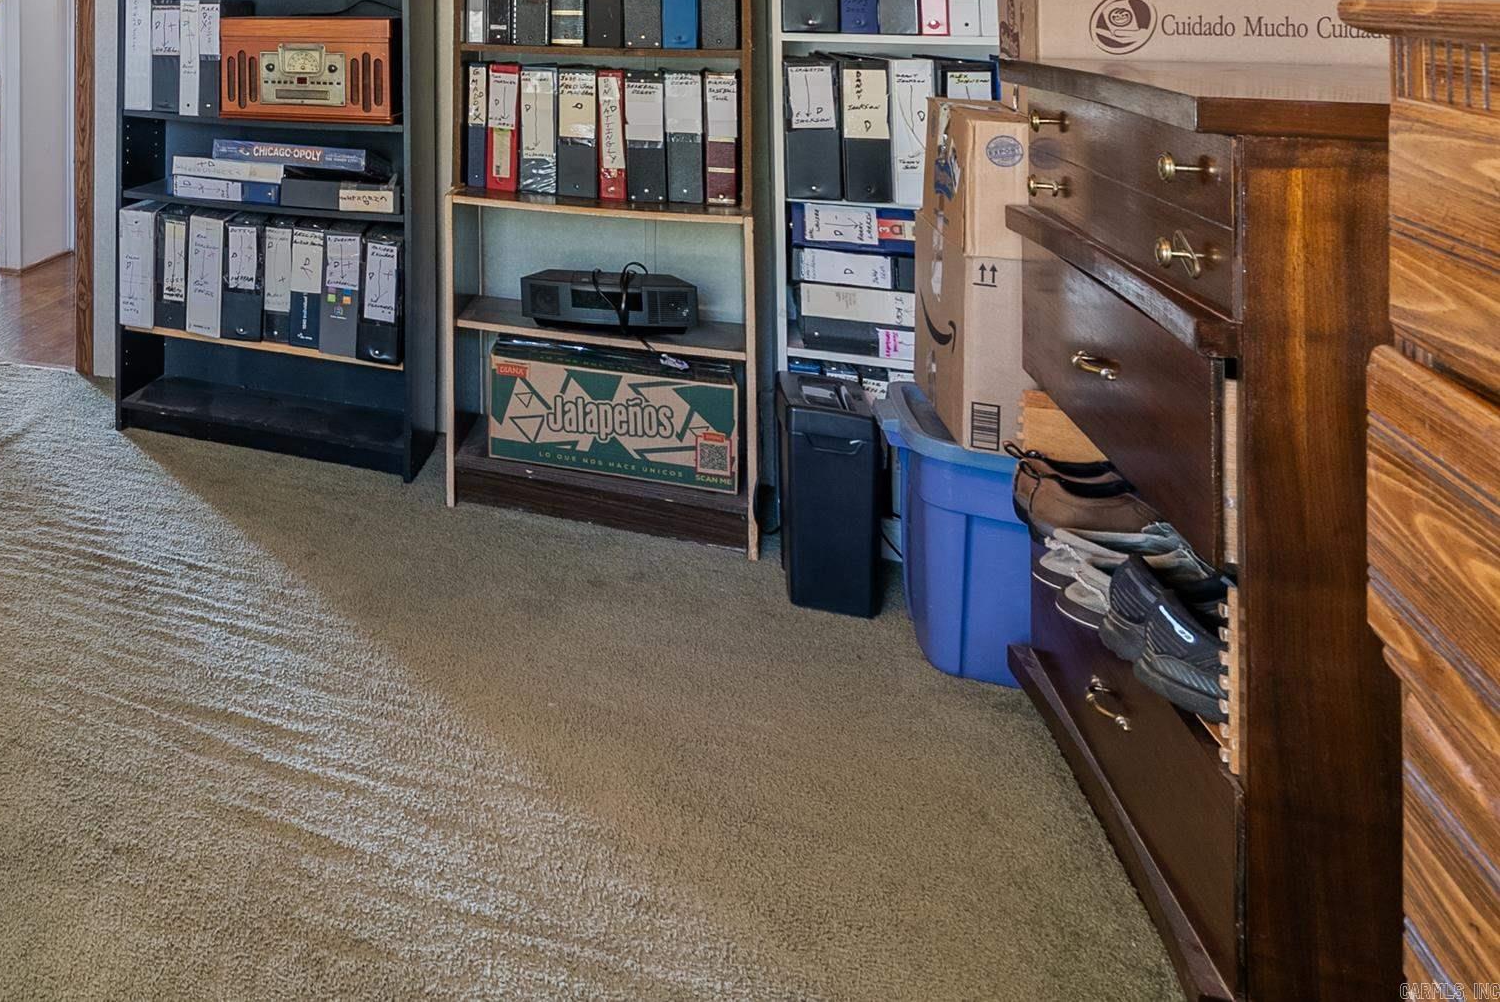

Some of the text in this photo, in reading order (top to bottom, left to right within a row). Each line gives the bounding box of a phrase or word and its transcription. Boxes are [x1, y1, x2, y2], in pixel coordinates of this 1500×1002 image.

[1161, 14, 1309, 38] Cuidado Mucho
[547, 395, 675, 443] Jalapeños
[538, 450, 552, 459] LO
[556, 453, 578, 463] QUE
[582, 456, 604, 466] NOS
[608, 460, 637, 470] HACE
[695, 474, 718, 486] SCAN
